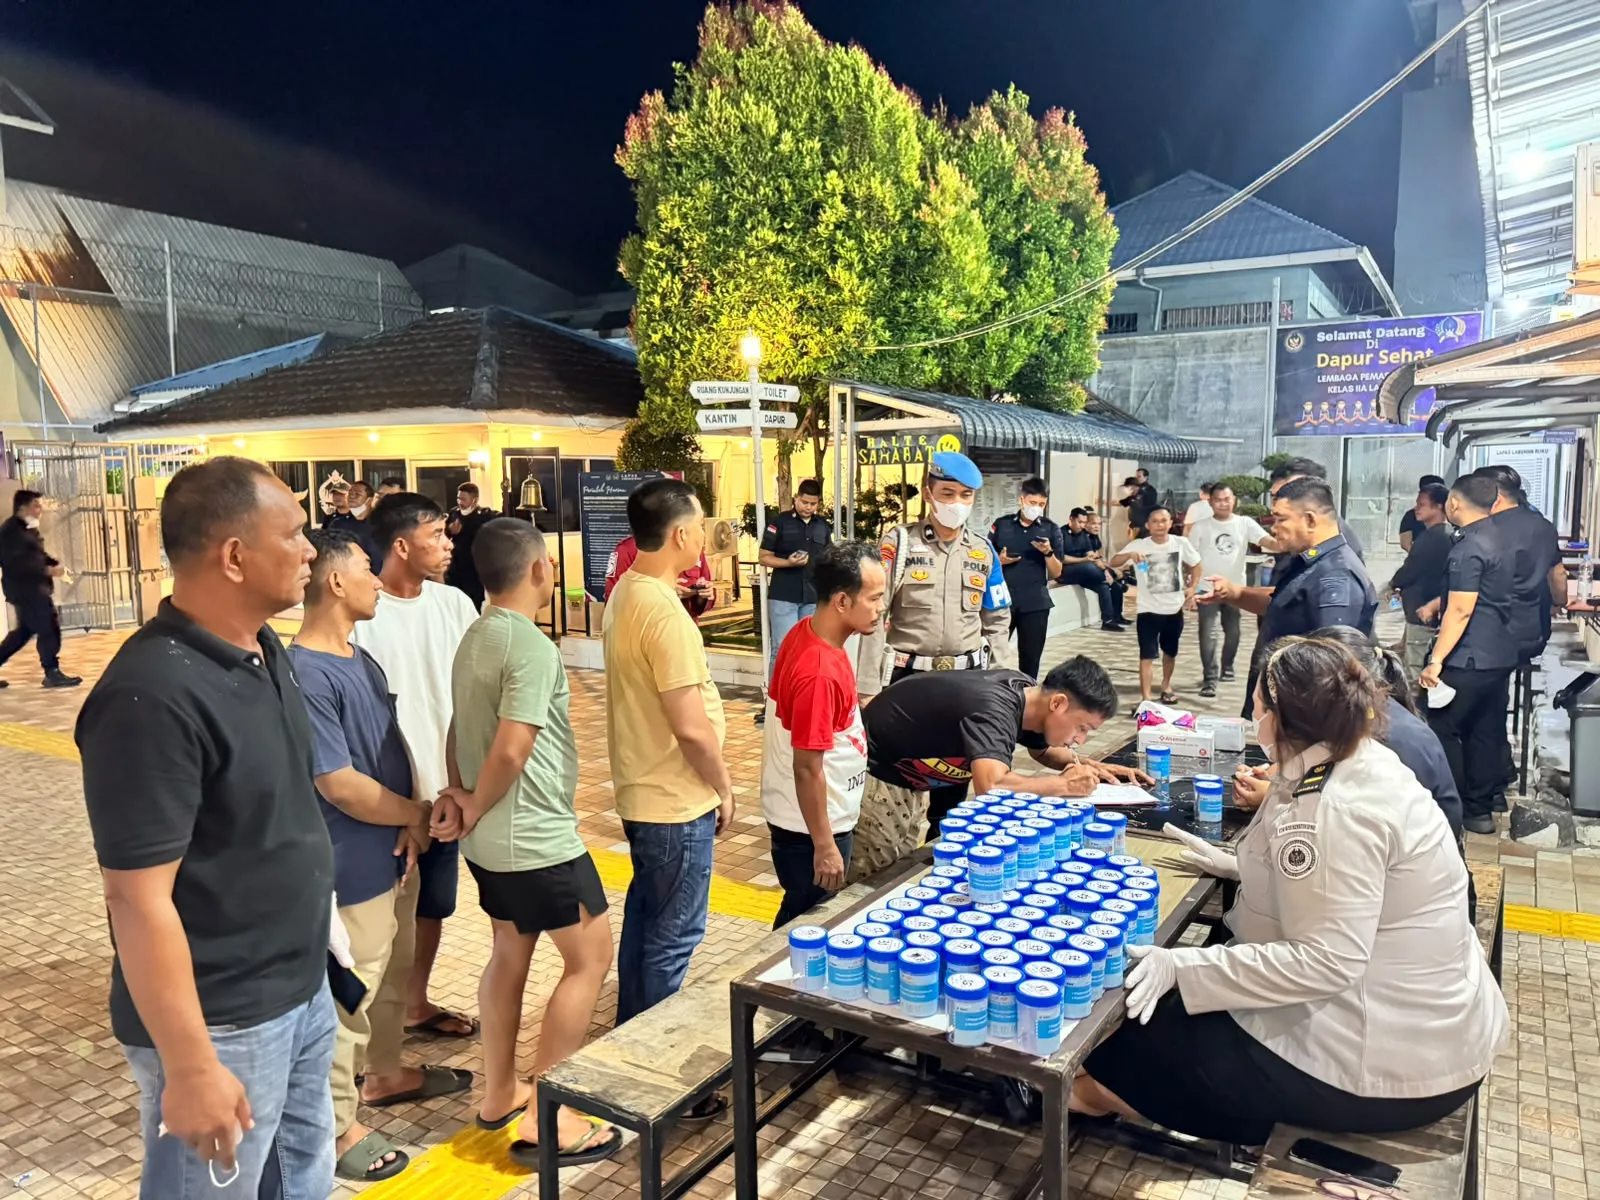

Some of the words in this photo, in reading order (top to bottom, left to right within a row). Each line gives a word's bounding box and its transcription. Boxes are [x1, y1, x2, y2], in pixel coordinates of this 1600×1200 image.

[1316, 328, 1373, 342] Selamat
[1376, 326, 1426, 338] Datang
[1366, 339, 1379, 349] Di
[1316, 352, 1374, 371] Dapur
[1378, 347, 1434, 365] Sehat
[1317, 373, 1359, 383] LEMBAGA
[697, 386, 717, 394] RUANG
[764, 387, 788, 398] TOILET
[1327, 385, 1354, 394] KELAS
[704, 414, 737, 424] KANTIN
[764, 414, 786, 425] DAPUR
[867, 435, 927, 448] HALTE
